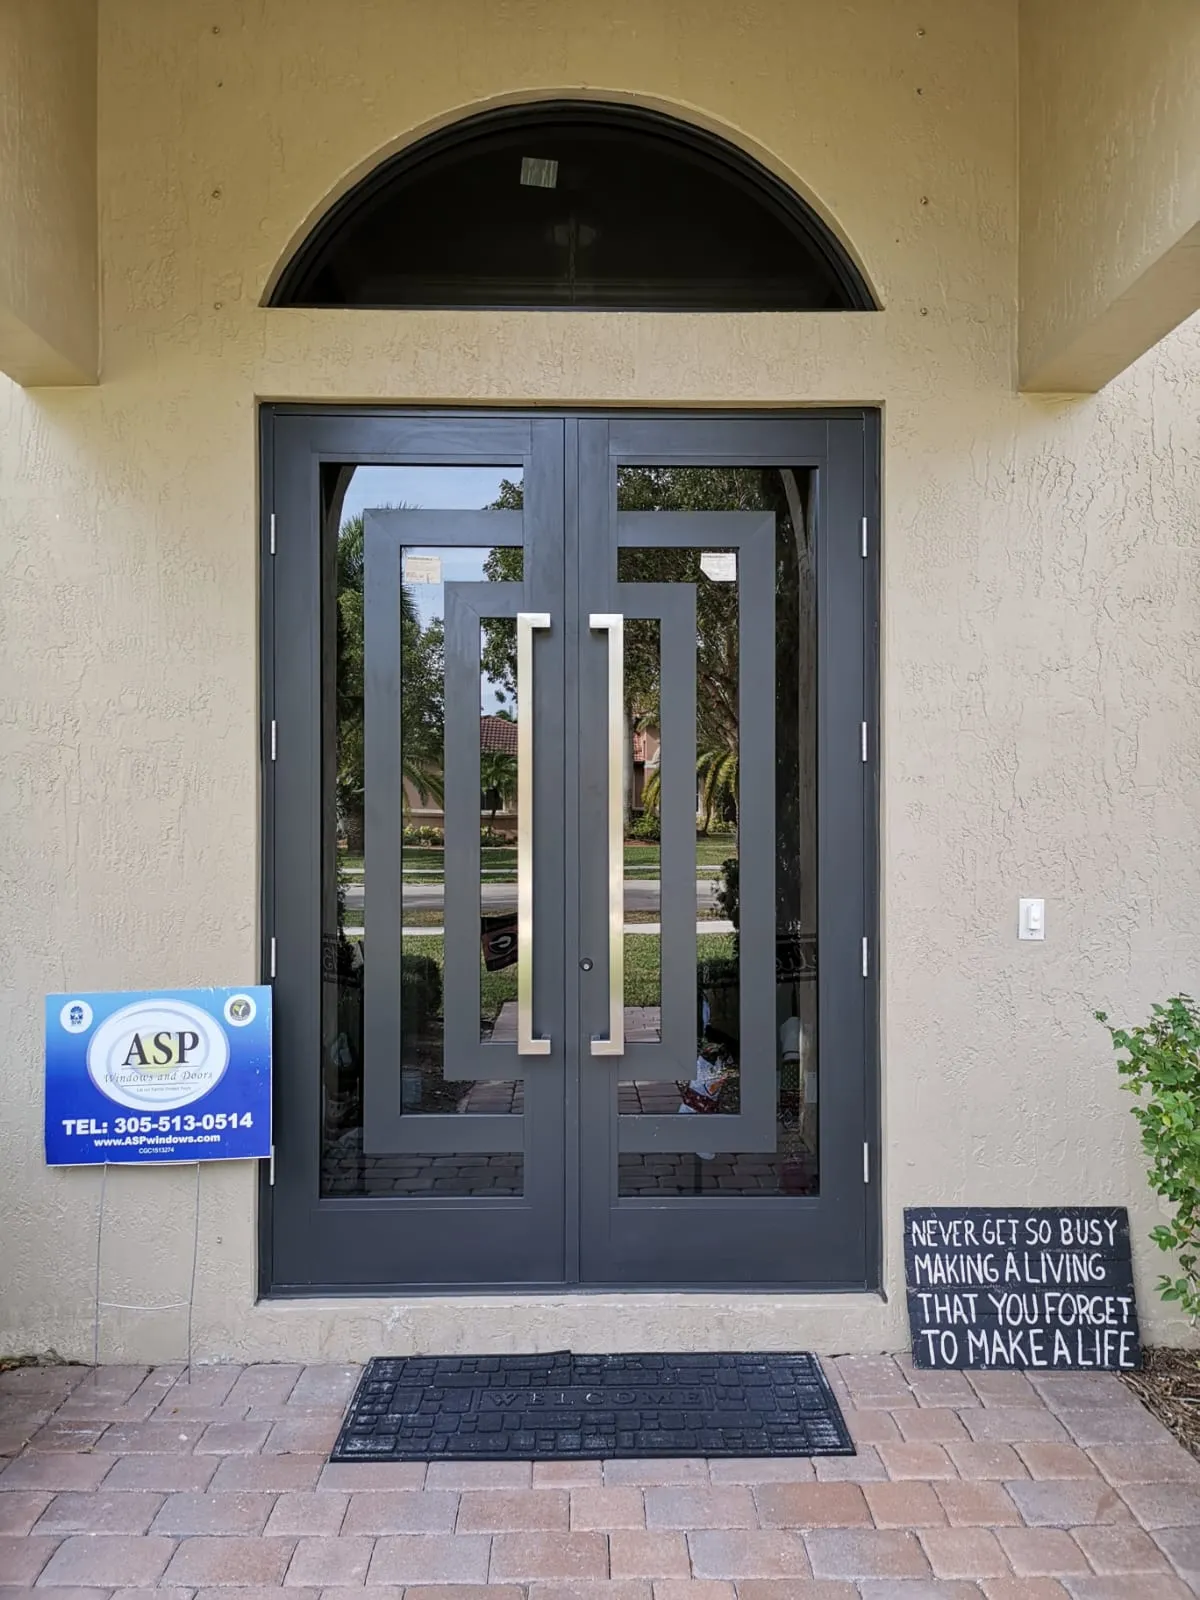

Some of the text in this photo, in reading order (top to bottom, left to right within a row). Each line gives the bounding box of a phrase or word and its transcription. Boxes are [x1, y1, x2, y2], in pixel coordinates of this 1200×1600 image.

[121, 1031, 200, 1066] ASP
[104, 1070, 213, 1084] Windows and Doors
[62, 1112, 253, 1135] TEL: 305-513-0514
[93, 1134, 221, 1147] www.ASPwindows.com
[911, 1217, 1118, 1247] NEVER GET SO BUSY
[914, 1251, 1106, 1285] MAKING A LIVING
[917, 1292, 1132, 1326] THAT YOU FORGET
[920, 1328, 1135, 1367] TO MAKE A LIFE
